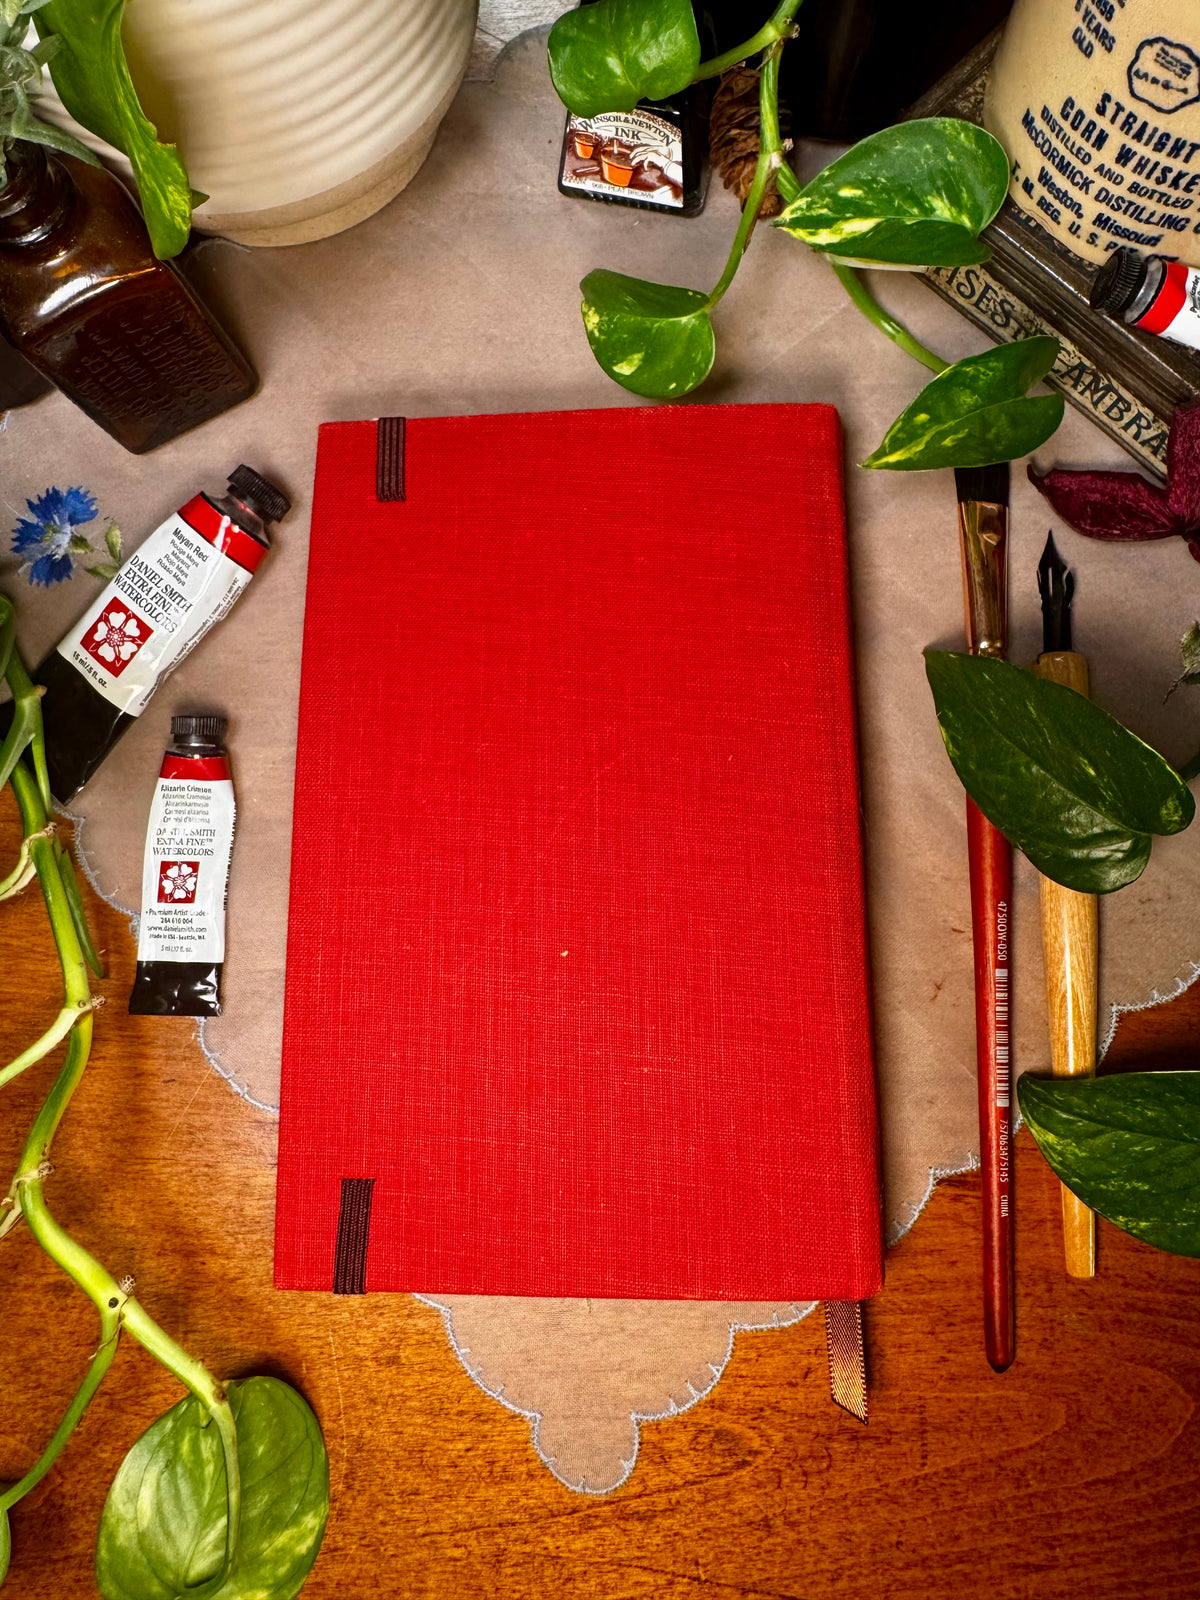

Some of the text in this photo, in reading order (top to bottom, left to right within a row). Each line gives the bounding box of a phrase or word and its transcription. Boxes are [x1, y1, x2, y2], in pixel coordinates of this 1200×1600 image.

[1072, 26, 1094, 59] OLD
[1082, 4, 1116, 53] YEARS
[614, 127, 641, 141] INK
[1095, 92, 1200, 163] STRAIGHT
[1041, 104, 1194, 210] DISTILLED AND BOTTLED
[1060, 96, 1200, 195] CORN WHISKE
[1022, 108, 1191, 232] McCORMICK DISTILLING
[1036, 196, 1061, 225] REG.
[1068, 221, 1081, 239] U.
[1086, 232, 1099, 247] S.
[1038, 166, 1084, 219] Weston,
[1092, 213, 1164, 247] Missouri
[170, 539, 199, 568] Rouge Maya
[172, 527, 209, 562] Mayan Red
[124, 567, 153, 596] EXTRA
[156, 558, 186, 587] Rosso Maya
[163, 553, 189, 579] Rojo Maya
[130, 555, 164, 588] DANIEL
[161, 584, 193, 613] SMITH
[114, 573, 178, 633] WATERCOLORS
[73, 651, 81, 661] 15
[98, 677, 107, 689] oz.
[161, 784, 212, 793] Alizarin Crimson
[189, 828, 216, 837] SMITH
[152, 847, 215, 856] WATERCOLORS
[1000, 1194, 1009, 1218] CHINA
